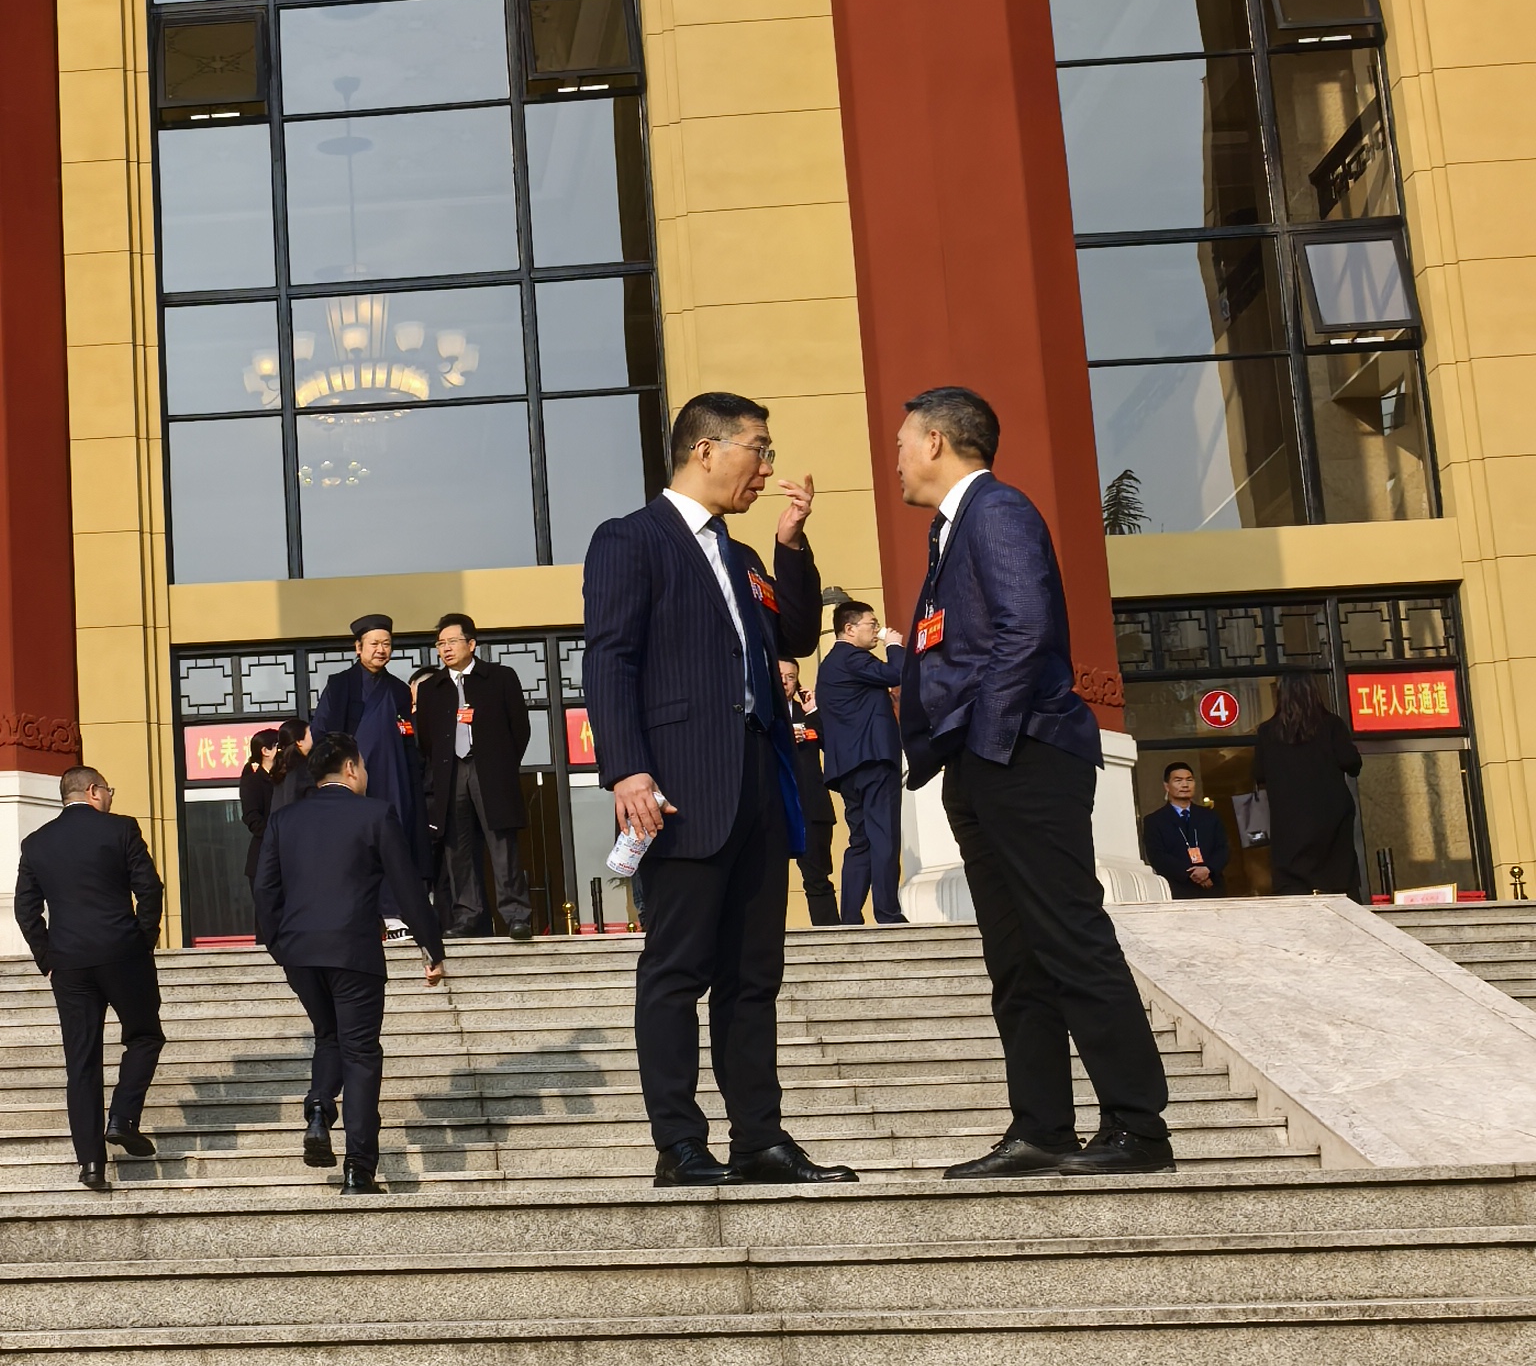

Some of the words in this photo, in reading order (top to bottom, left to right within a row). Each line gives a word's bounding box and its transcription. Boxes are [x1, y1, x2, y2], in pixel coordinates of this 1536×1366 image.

[1209, 695, 1229, 722] 4
[1357, 681, 1450, 717] 工作人员通道
